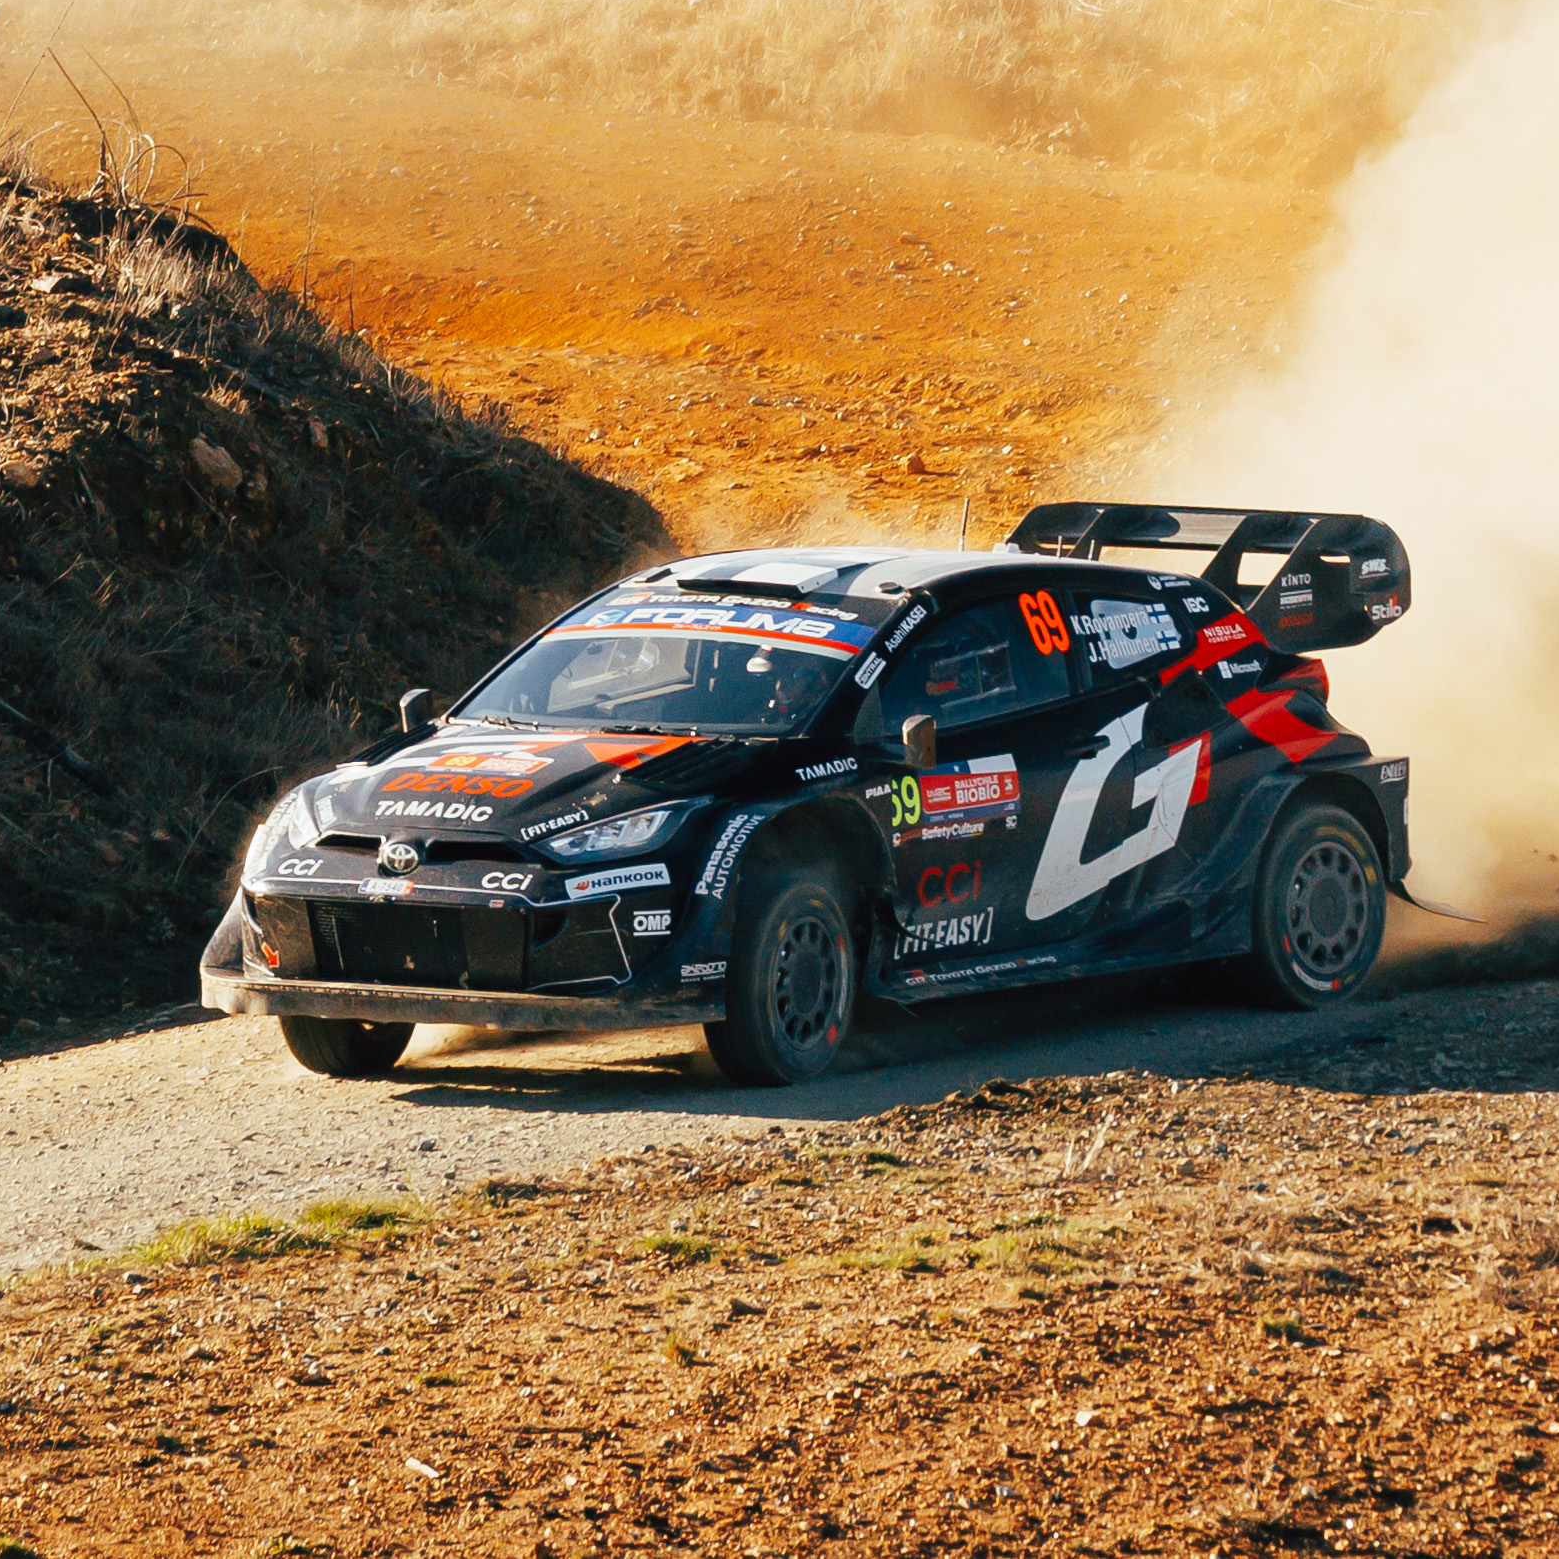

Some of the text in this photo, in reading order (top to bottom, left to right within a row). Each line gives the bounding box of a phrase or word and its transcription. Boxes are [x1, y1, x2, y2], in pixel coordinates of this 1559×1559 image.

[791, 602, 860, 621] Racing
[1371, 601, 1403, 620] Stilo
[625, 607, 836, 639] FORUM8
[885, 604, 927, 653] AsahiKASEI
[1018, 590, 1070, 656] 69
[1203, 623, 1244, 638] NISULA
[795, 757, 858, 782] TAMADIC
[382, 773, 534, 798] DENSO
[866, 784, 892, 799] PIAA
[375, 800, 494, 823] TAMADIC
[922, 822, 985, 841] SafetyCulture
[695, 813, 749, 895] Panasonic
[711, 813, 766, 899] AUTOMOTIVE
[633, 914, 671, 932] OMP
